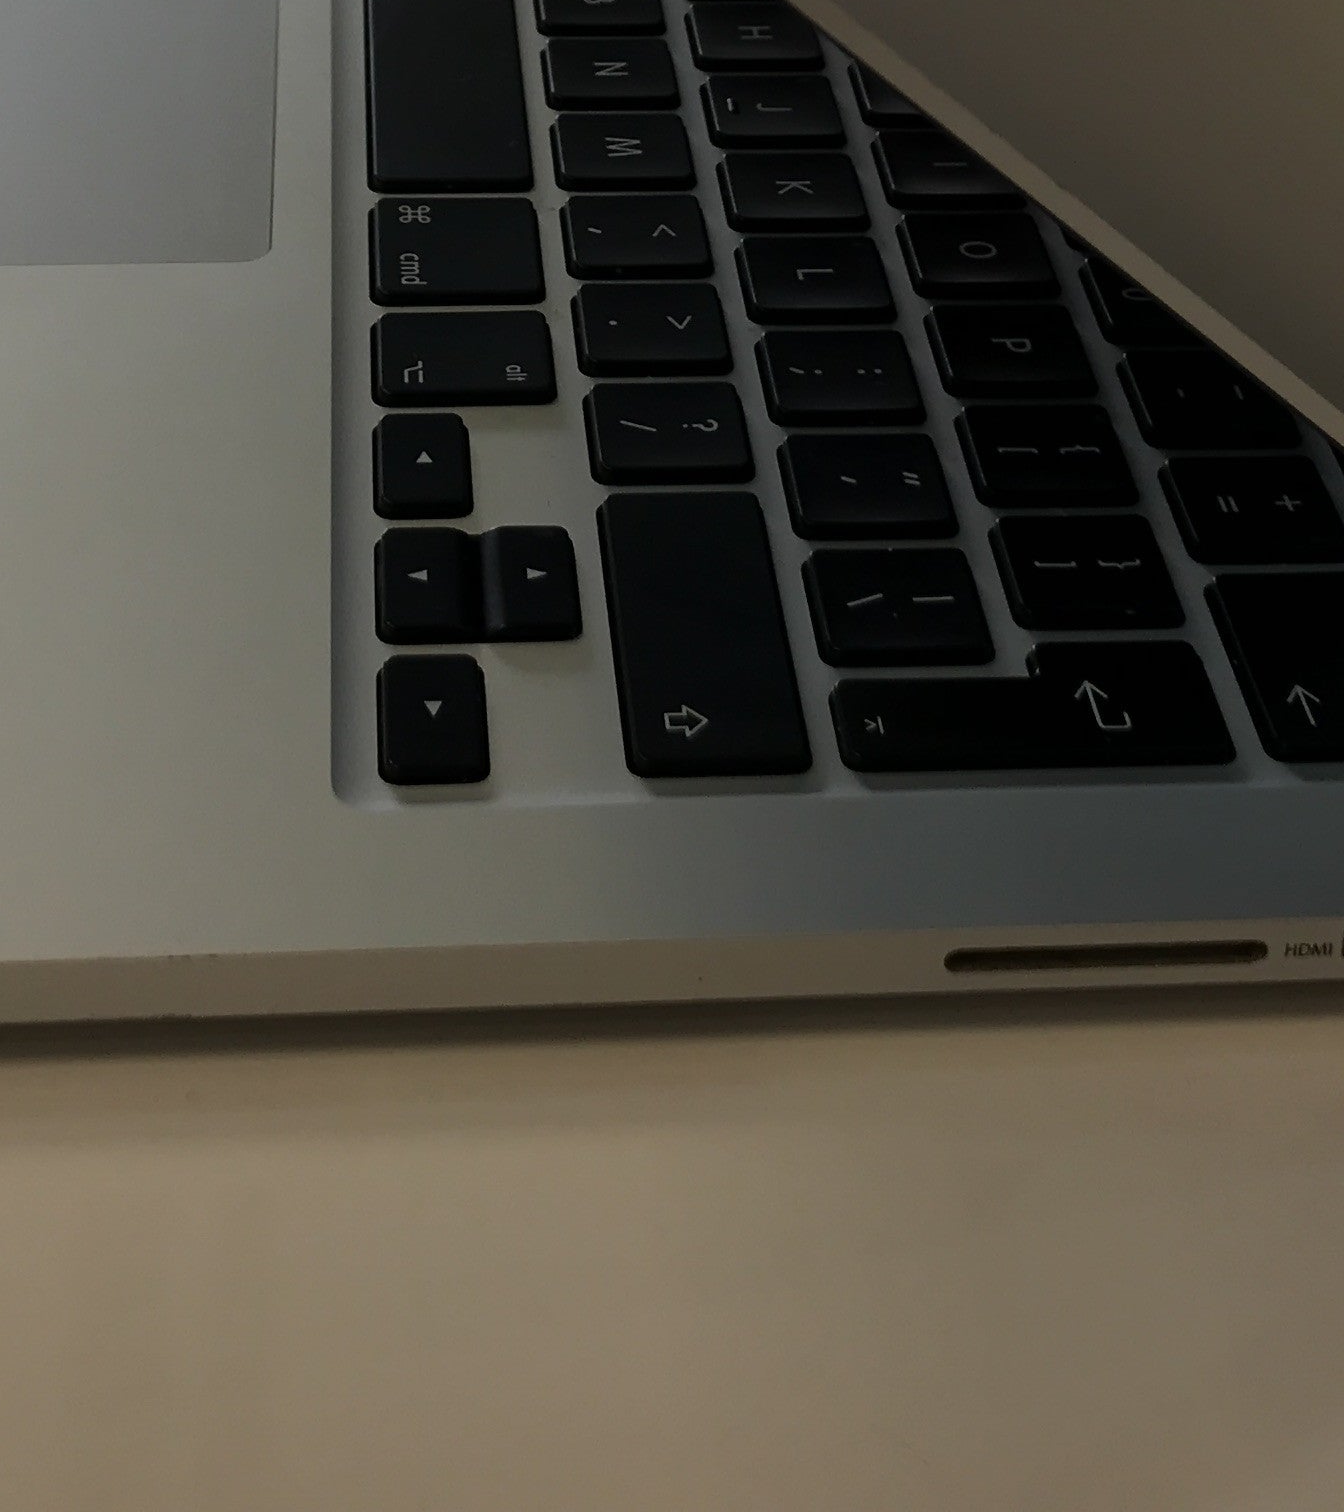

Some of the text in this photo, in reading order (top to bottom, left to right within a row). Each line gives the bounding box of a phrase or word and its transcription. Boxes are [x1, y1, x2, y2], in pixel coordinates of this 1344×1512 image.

[738, 25, 773, 40] H
[593, 61, 629, 77] N
[754, 101, 794, 114] J
[604, 136, 643, 158] M
[775, 180, 814, 195] K
[958, 240, 998, 260] O
[399, 252, 428, 285] cmd
[796, 268, 834, 281] L
[989, 337, 1032, 353] P
[505, 364, 528, 382] alt
[682, 418, 719, 432] ?
[1284, 942, 1333, 957] HDMI
